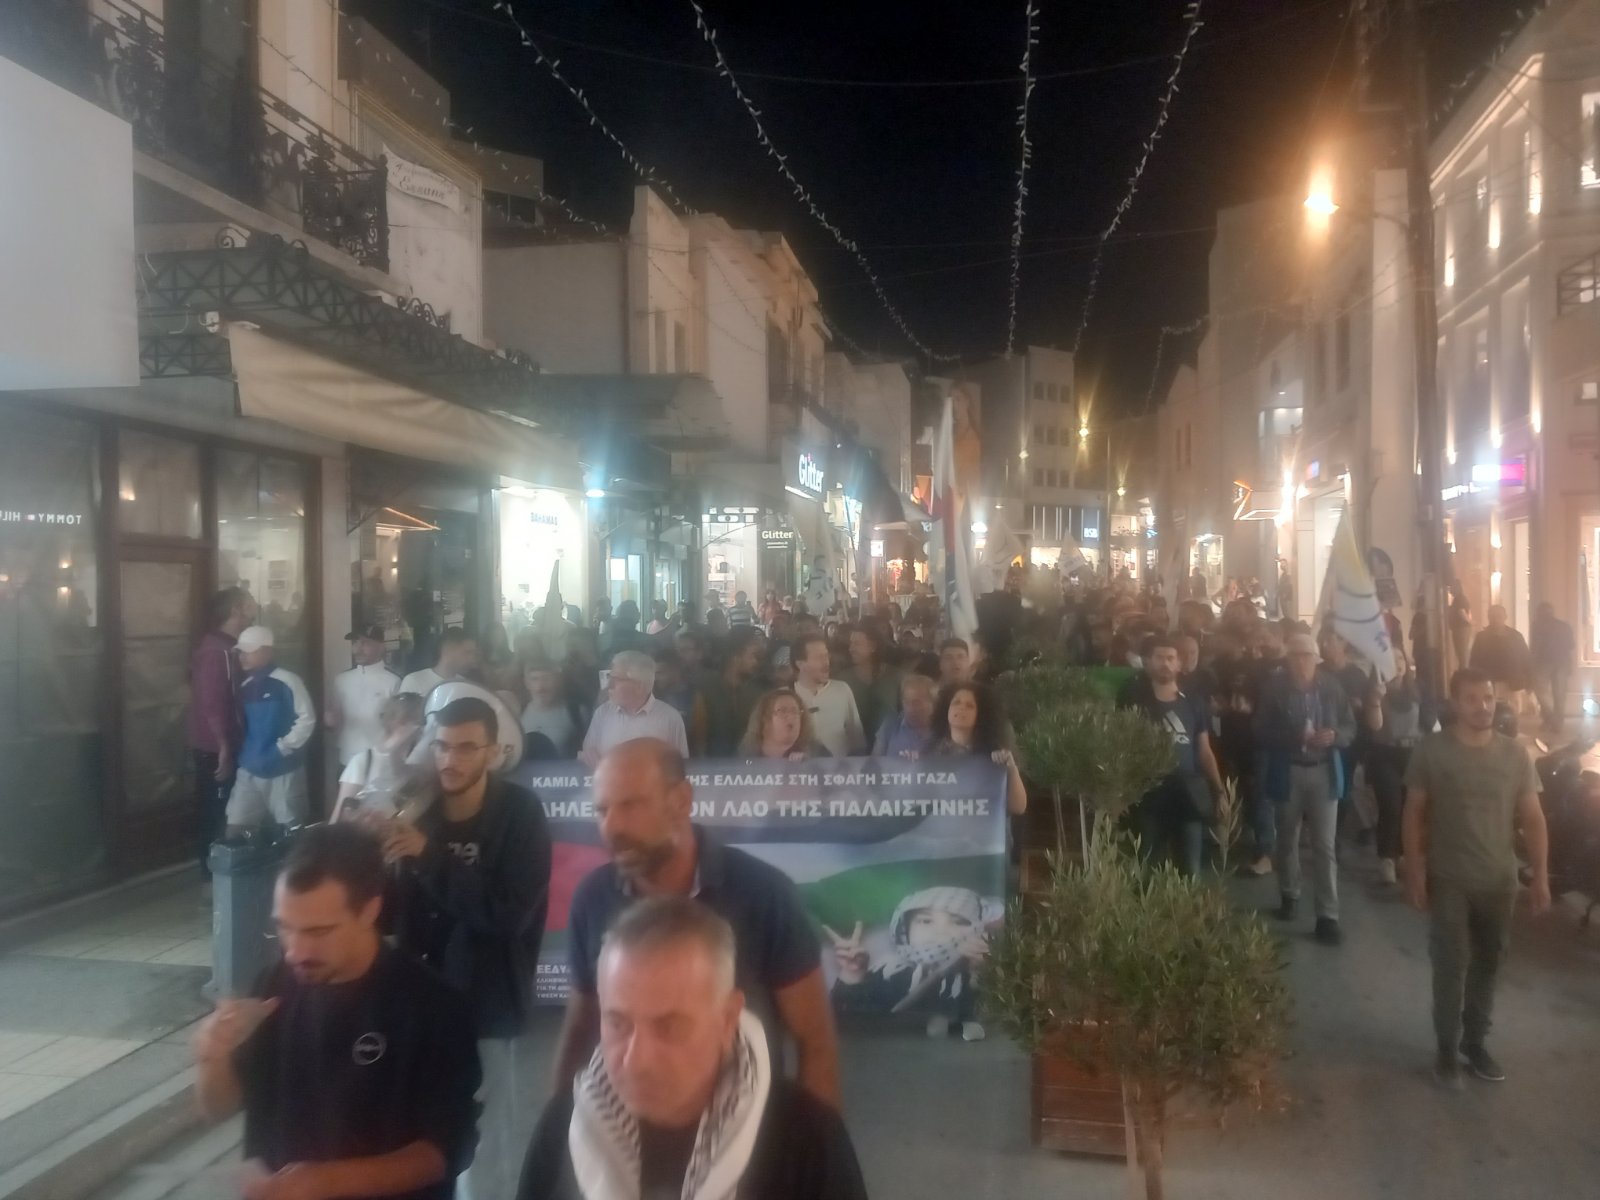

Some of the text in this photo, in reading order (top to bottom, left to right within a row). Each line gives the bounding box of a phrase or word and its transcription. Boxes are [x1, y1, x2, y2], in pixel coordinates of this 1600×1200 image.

[798, 453, 824, 493] Glitter
[761, 530, 793, 539] Glitter
[532, 775, 579, 788] ΚΑΜΙΑ
[713, 773, 784, 787] ΕΛΛΑΔΑΣ
[788, 773, 818, 786] ΣΤΗ
[823, 773, 876, 786] ΣΦΑΓΗ
[881, 772, 912, 785] ΣΤΗ
[916, 772, 958, 785] ΓΑΖΑ
[722, 800, 769, 817] ΛΑΟ
[779, 799, 822, 817] ΤΗΣ
[829, 799, 990, 817] ΠΑΛΑΙΣΤΙΝΗΣ
